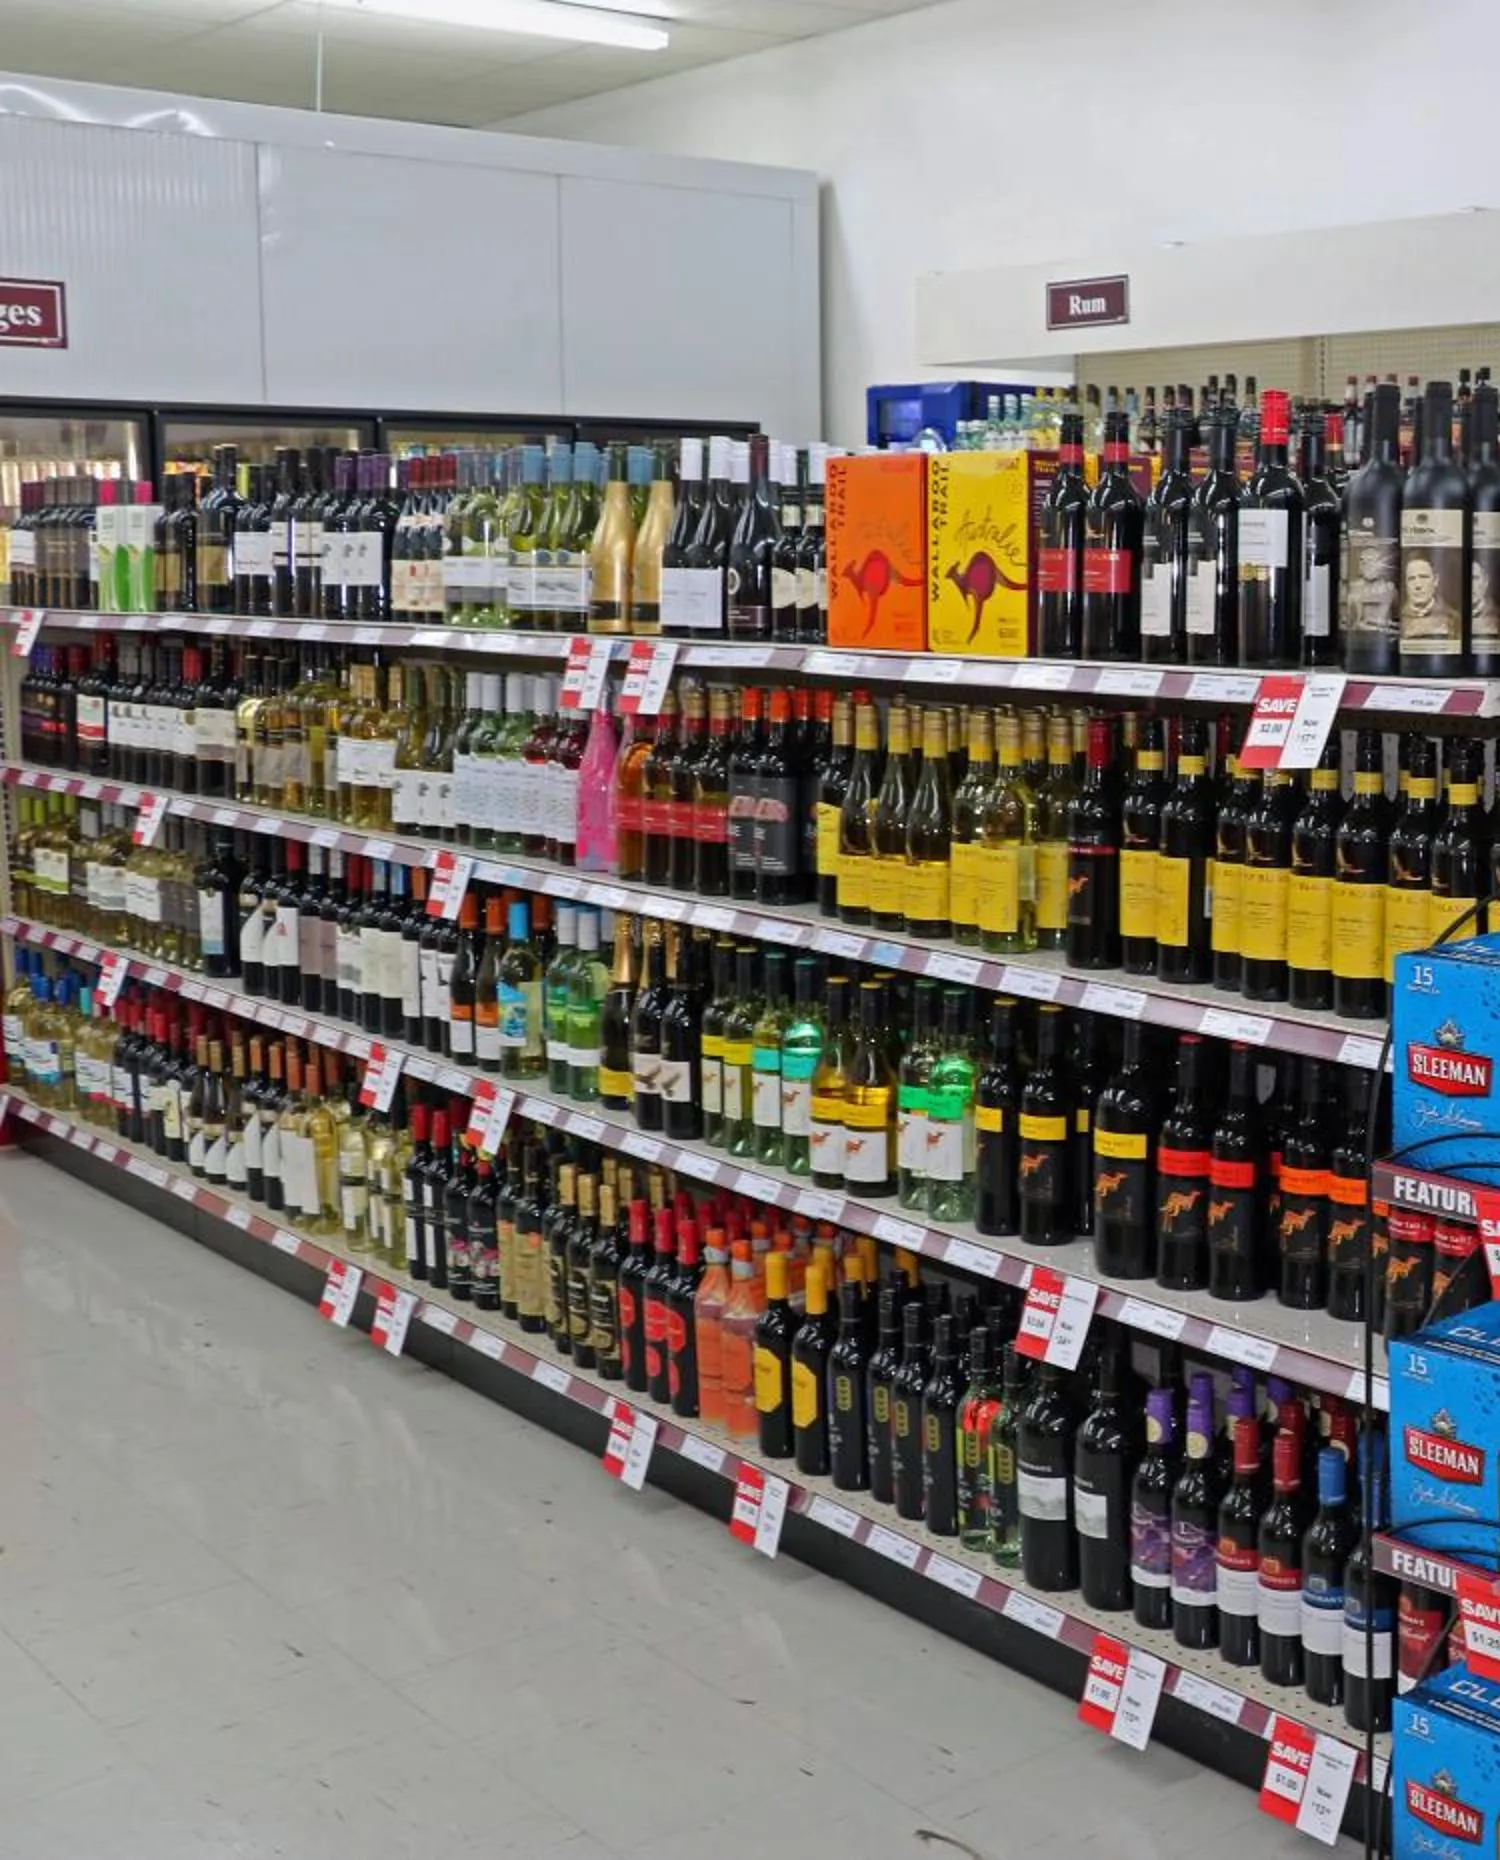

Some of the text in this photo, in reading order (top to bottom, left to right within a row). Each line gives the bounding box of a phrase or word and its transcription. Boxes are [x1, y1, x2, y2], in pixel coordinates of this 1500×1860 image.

[1069, 295, 1107, 315] Rum
[1257, 698, 1298, 713] SAVE
[1413, 965, 1434, 986] 15
[1411, 1053, 1487, 1087] SLEEMAN
[1408, 1353, 1428, 1375] 15
[1408, 1437, 1480, 1476] SLEEMAN
[1392, 1549, 1457, 1590] FEATU
[1091, 1655, 1125, 1681] SAVE
[1410, 1713, 1430, 1735] 15
[1272, 1741, 1311, 1768] SAVE
[1409, 1790, 1479, 1836] SLEEMAN
